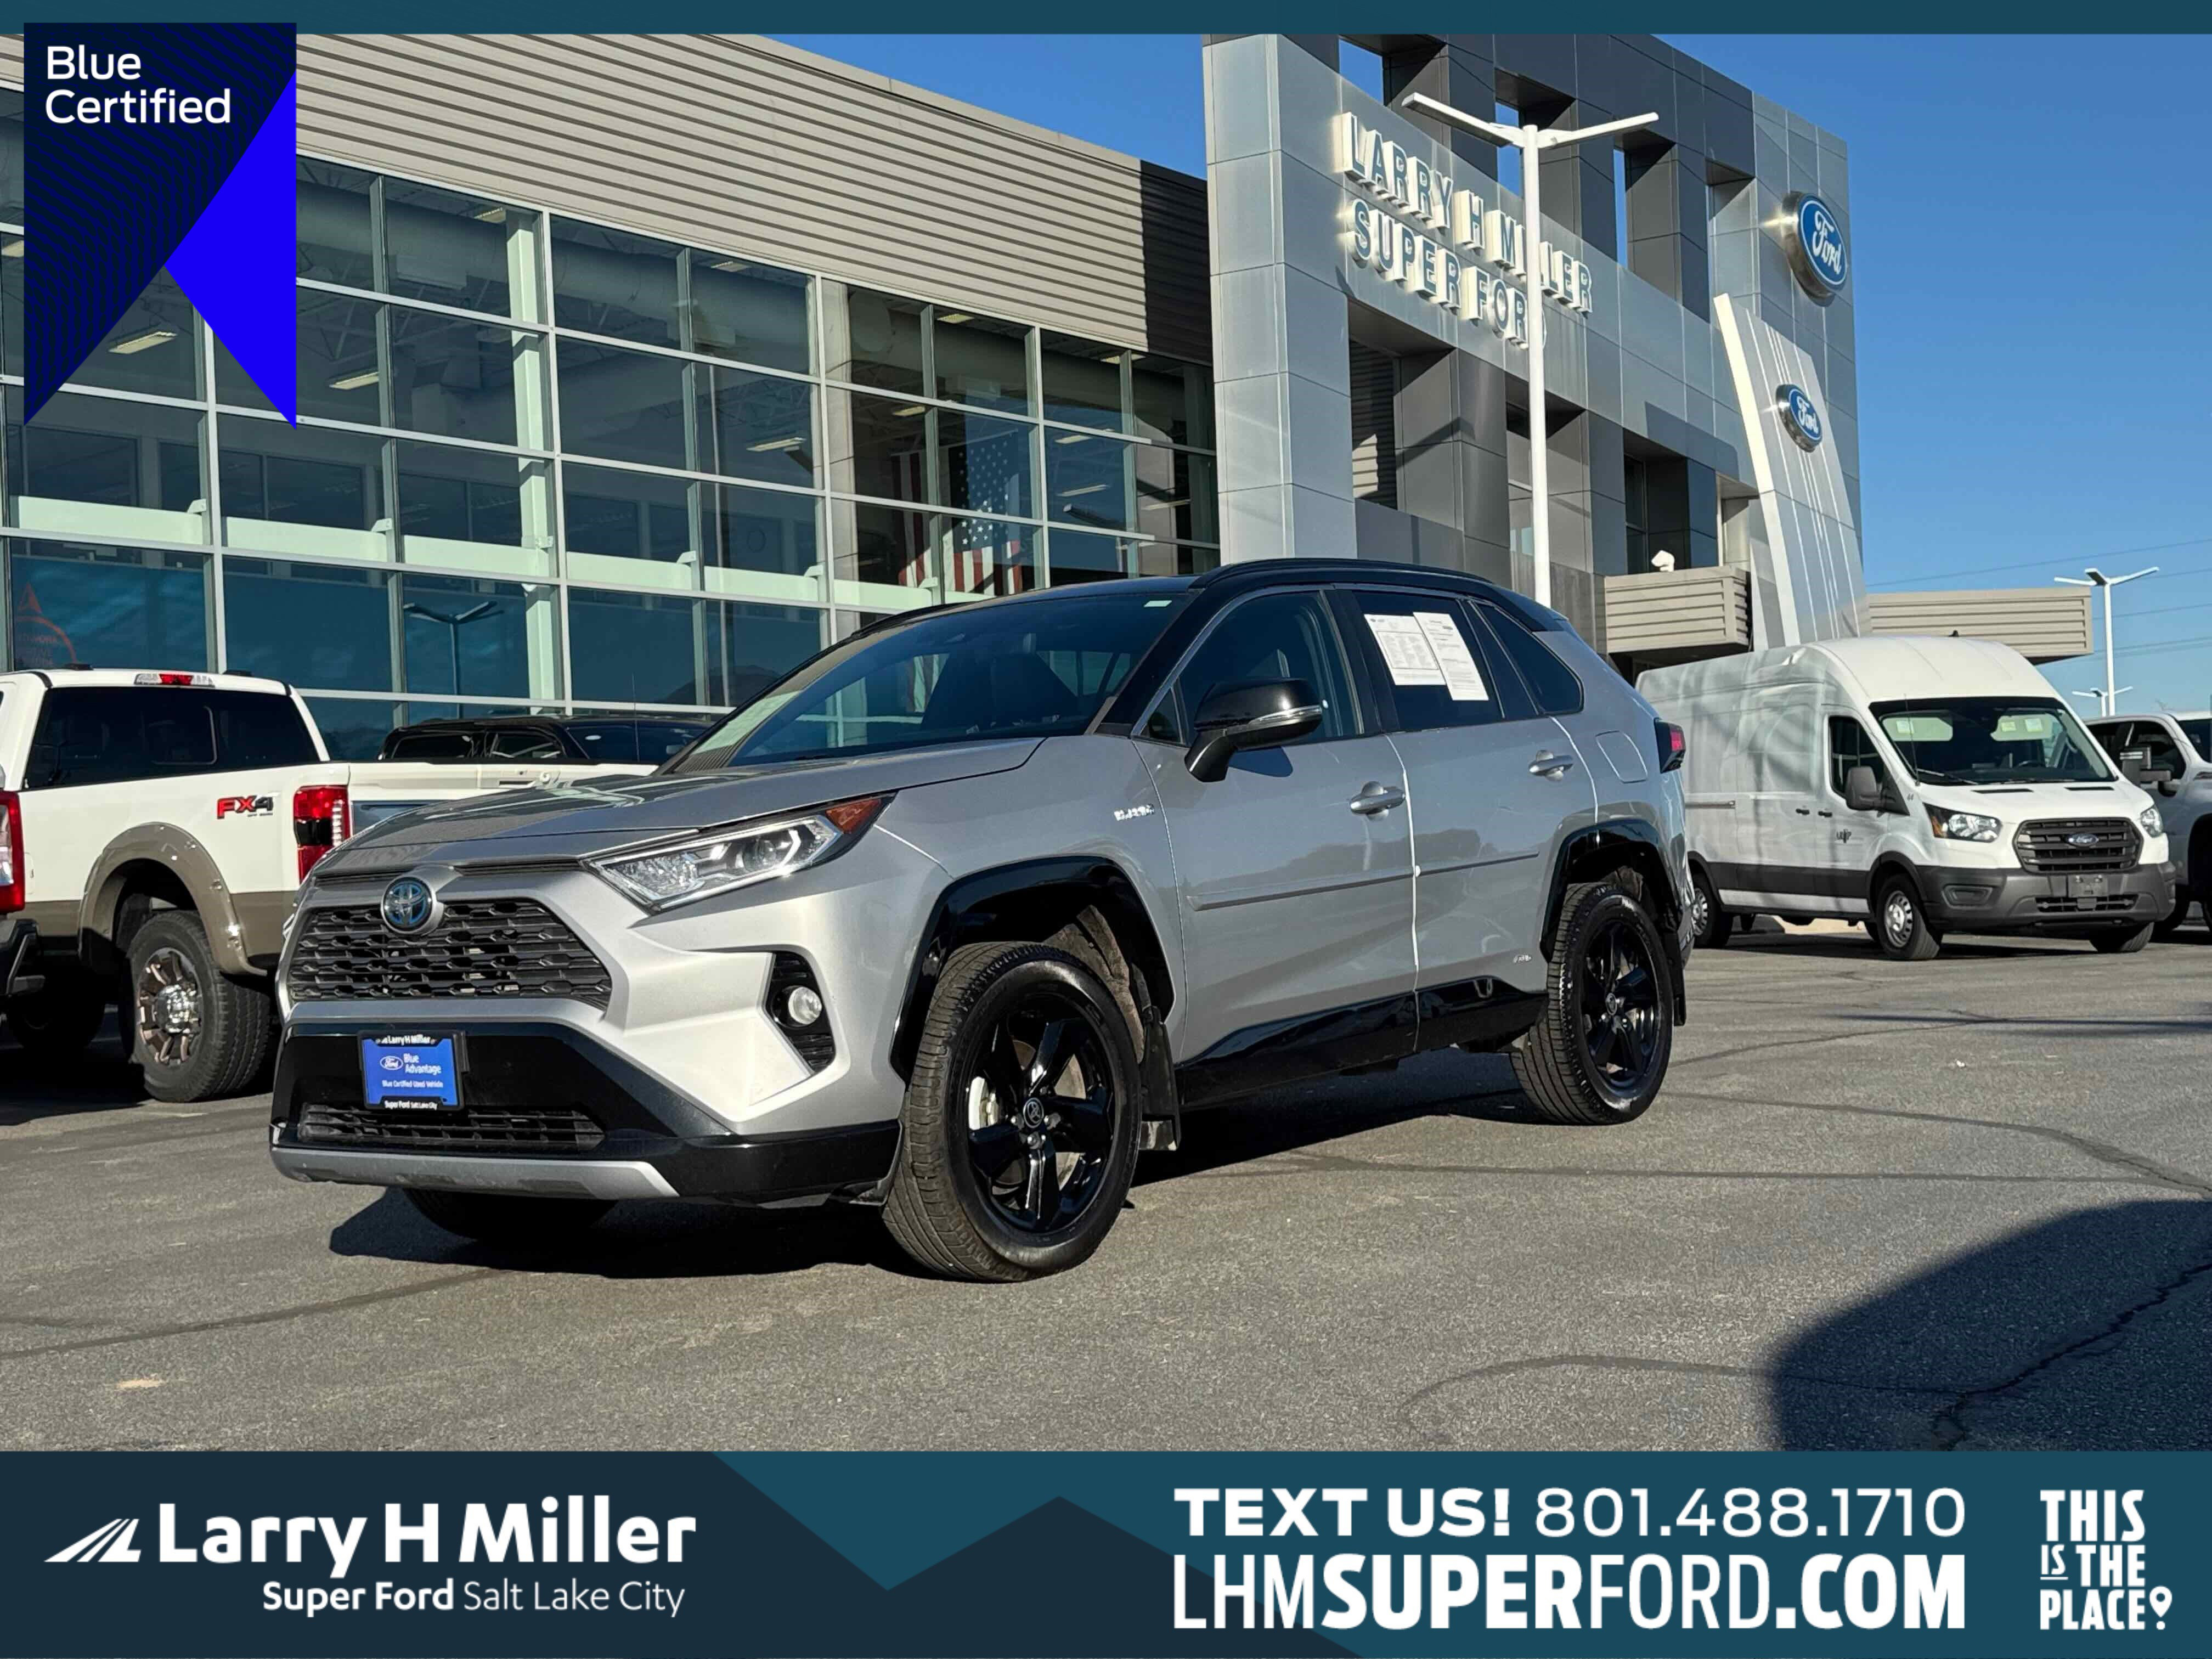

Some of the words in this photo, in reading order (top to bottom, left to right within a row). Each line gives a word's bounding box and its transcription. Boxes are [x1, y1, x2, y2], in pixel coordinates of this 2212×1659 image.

[1343, 112, 1453, 229] LARRY
[1457, 190, 1483, 251] H
[1485, 210, 1592, 313] MILER
[1812, 210, 1842, 275] Ford
[1347, 199, 1461, 308] SUPER
[1464, 267, 1547, 349] FOR
[217, 795, 274, 820] FX4
[403, 1053, 419, 1063] Blue
[405, 1063, 442, 1076] Advantage
